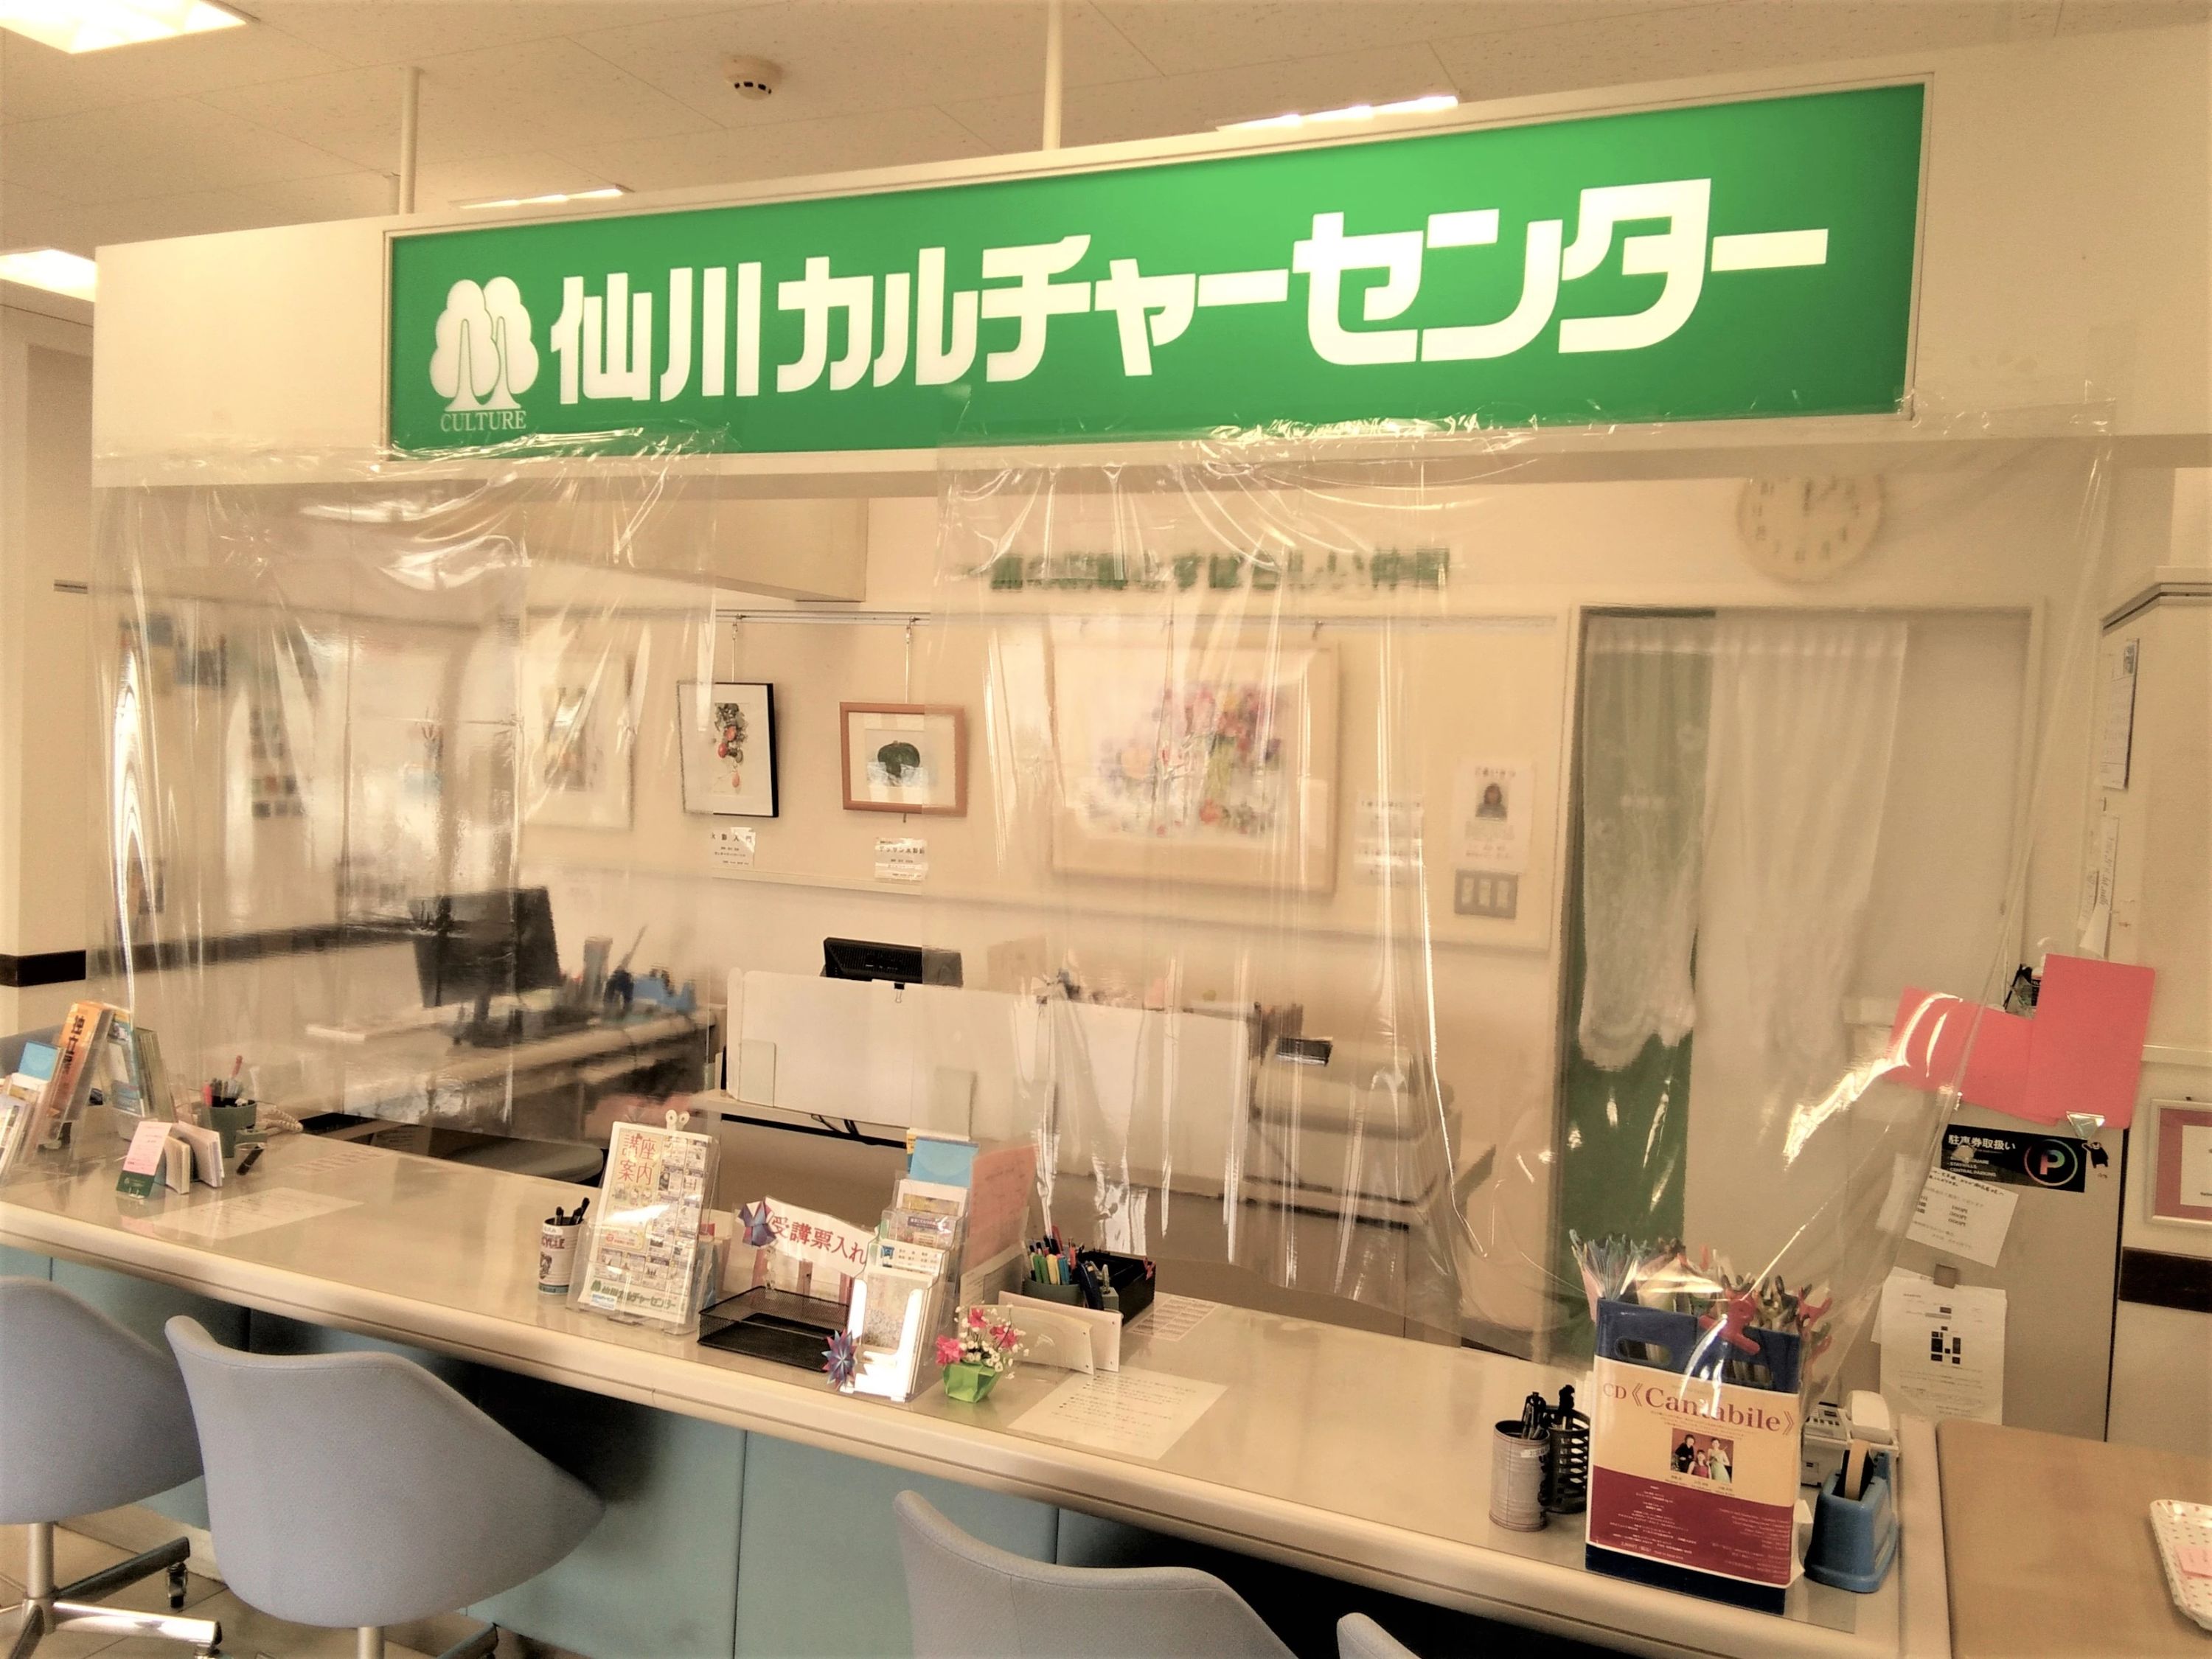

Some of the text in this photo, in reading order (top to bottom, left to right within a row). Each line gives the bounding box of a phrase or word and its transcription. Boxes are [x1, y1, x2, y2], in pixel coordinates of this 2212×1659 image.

[550, 178, 1829, 405] 仙川カルチャーセンター
[440, 410, 527, 432] CULTURE
[618, 1159, 653, 1186] 案内
[771, 1214, 868, 1265] 受講票入れ
[1603, 1382, 1627, 1399] CD
